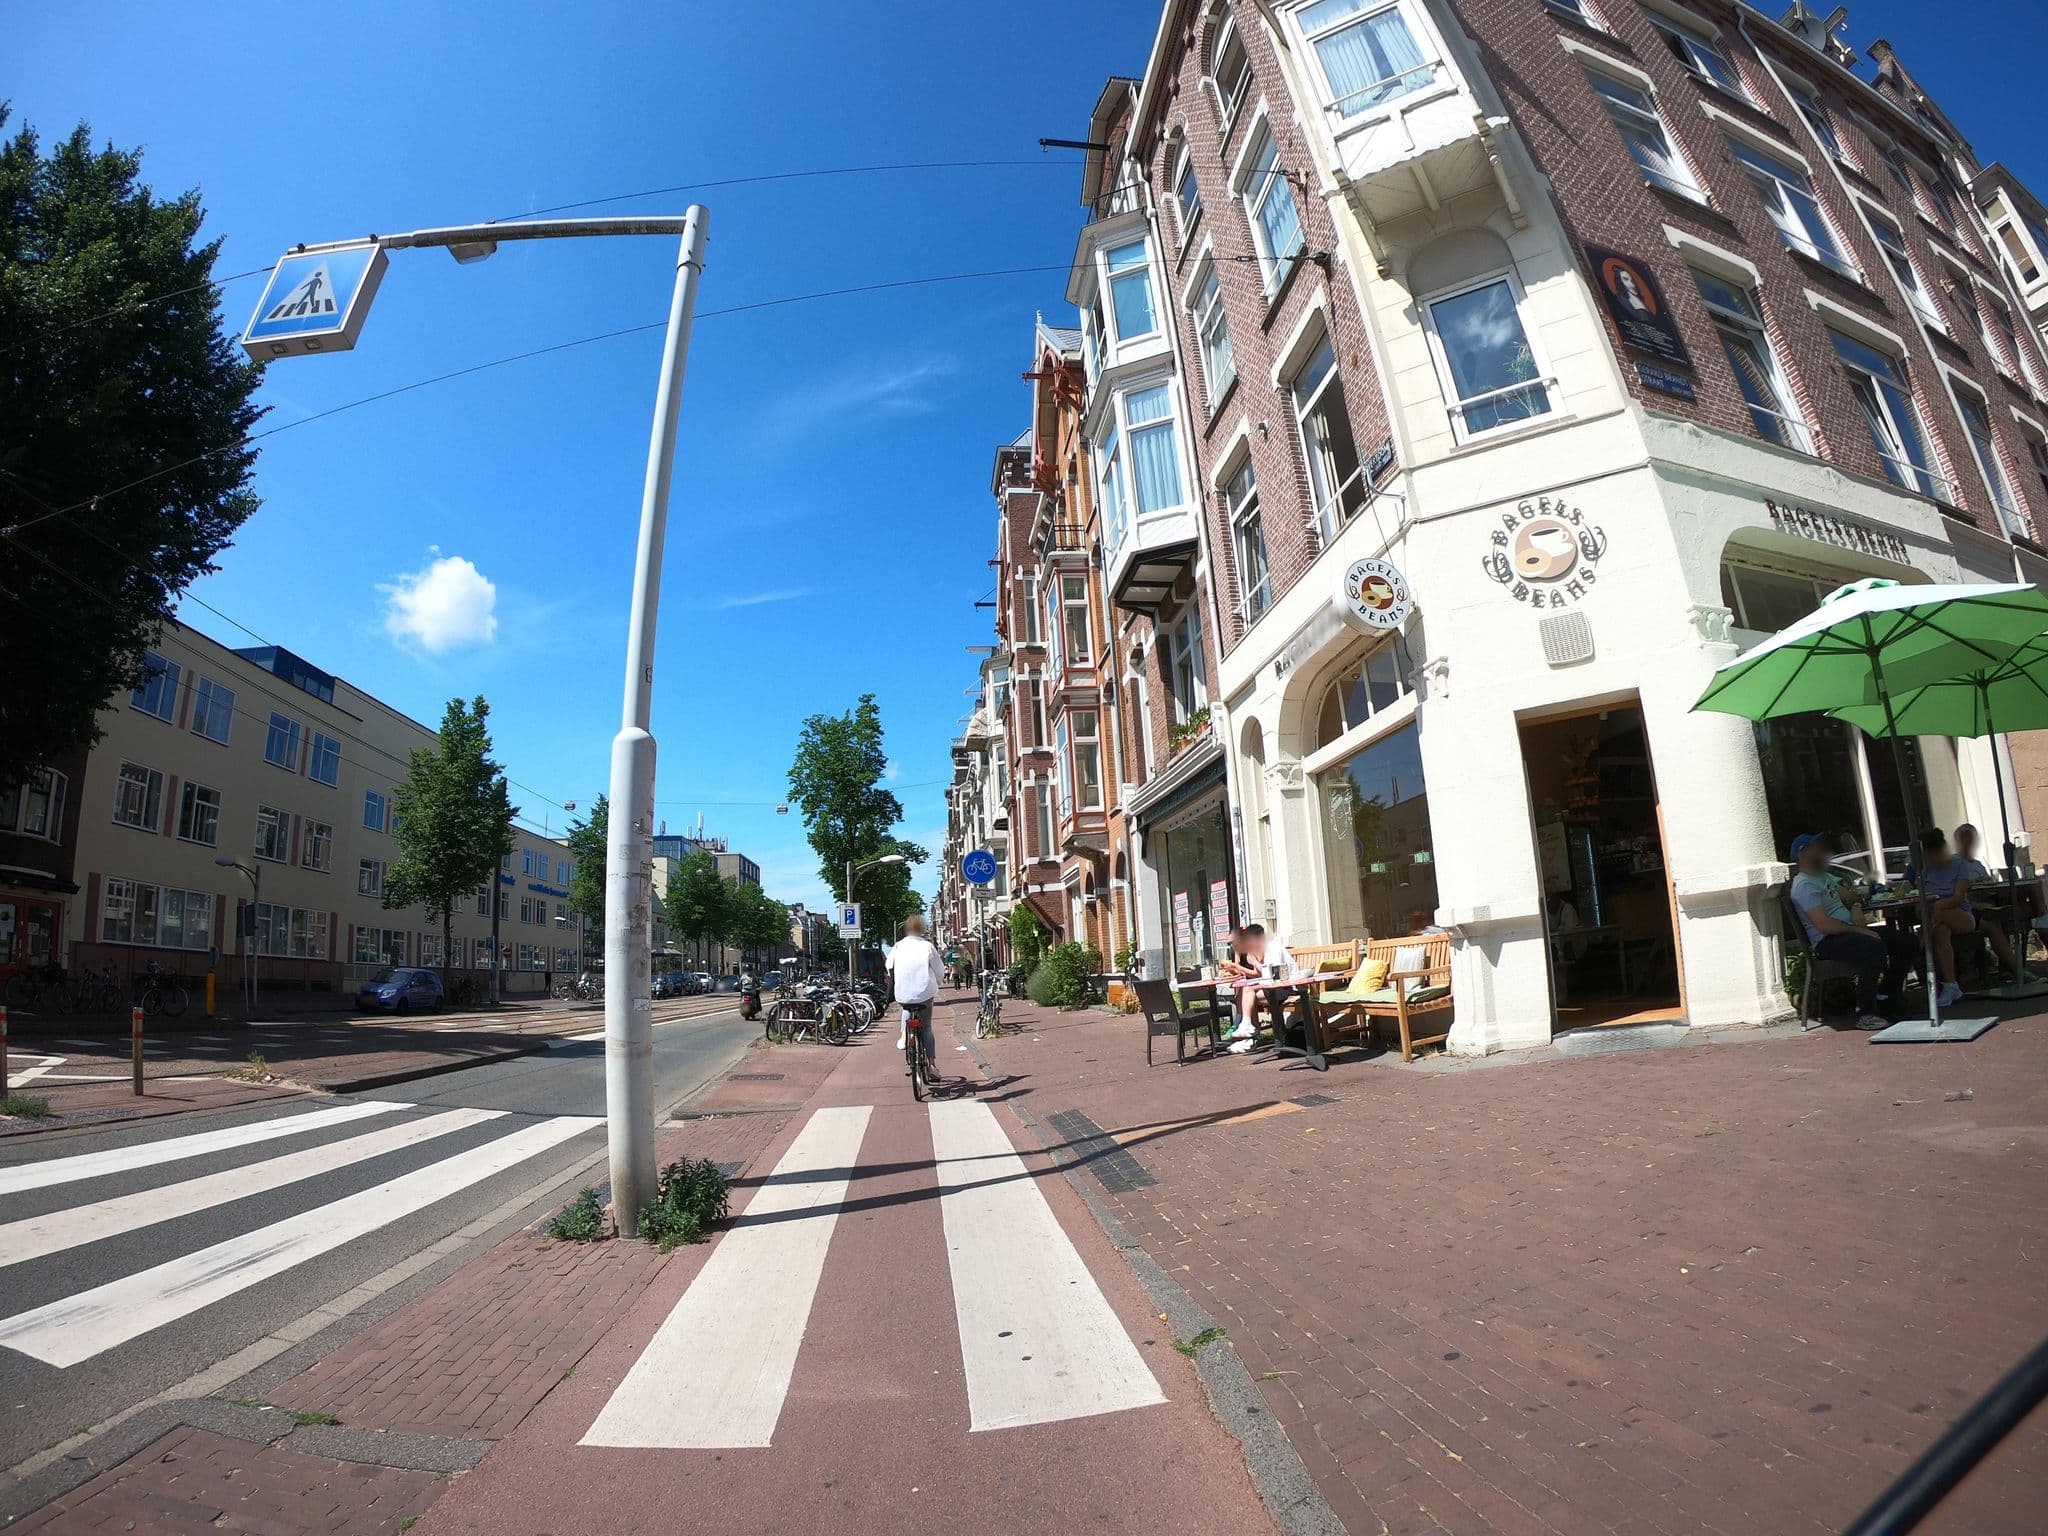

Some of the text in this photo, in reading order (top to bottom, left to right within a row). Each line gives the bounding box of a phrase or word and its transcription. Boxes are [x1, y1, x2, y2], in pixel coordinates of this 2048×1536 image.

[1491, 496, 1584, 548] BAGELS
[1349, 562, 1401, 585] BAGELS
[1511, 566, 1597, 609] BEANS
[1358, 604, 1405, 624] BEANS
[846, 910, 853, 920] P
